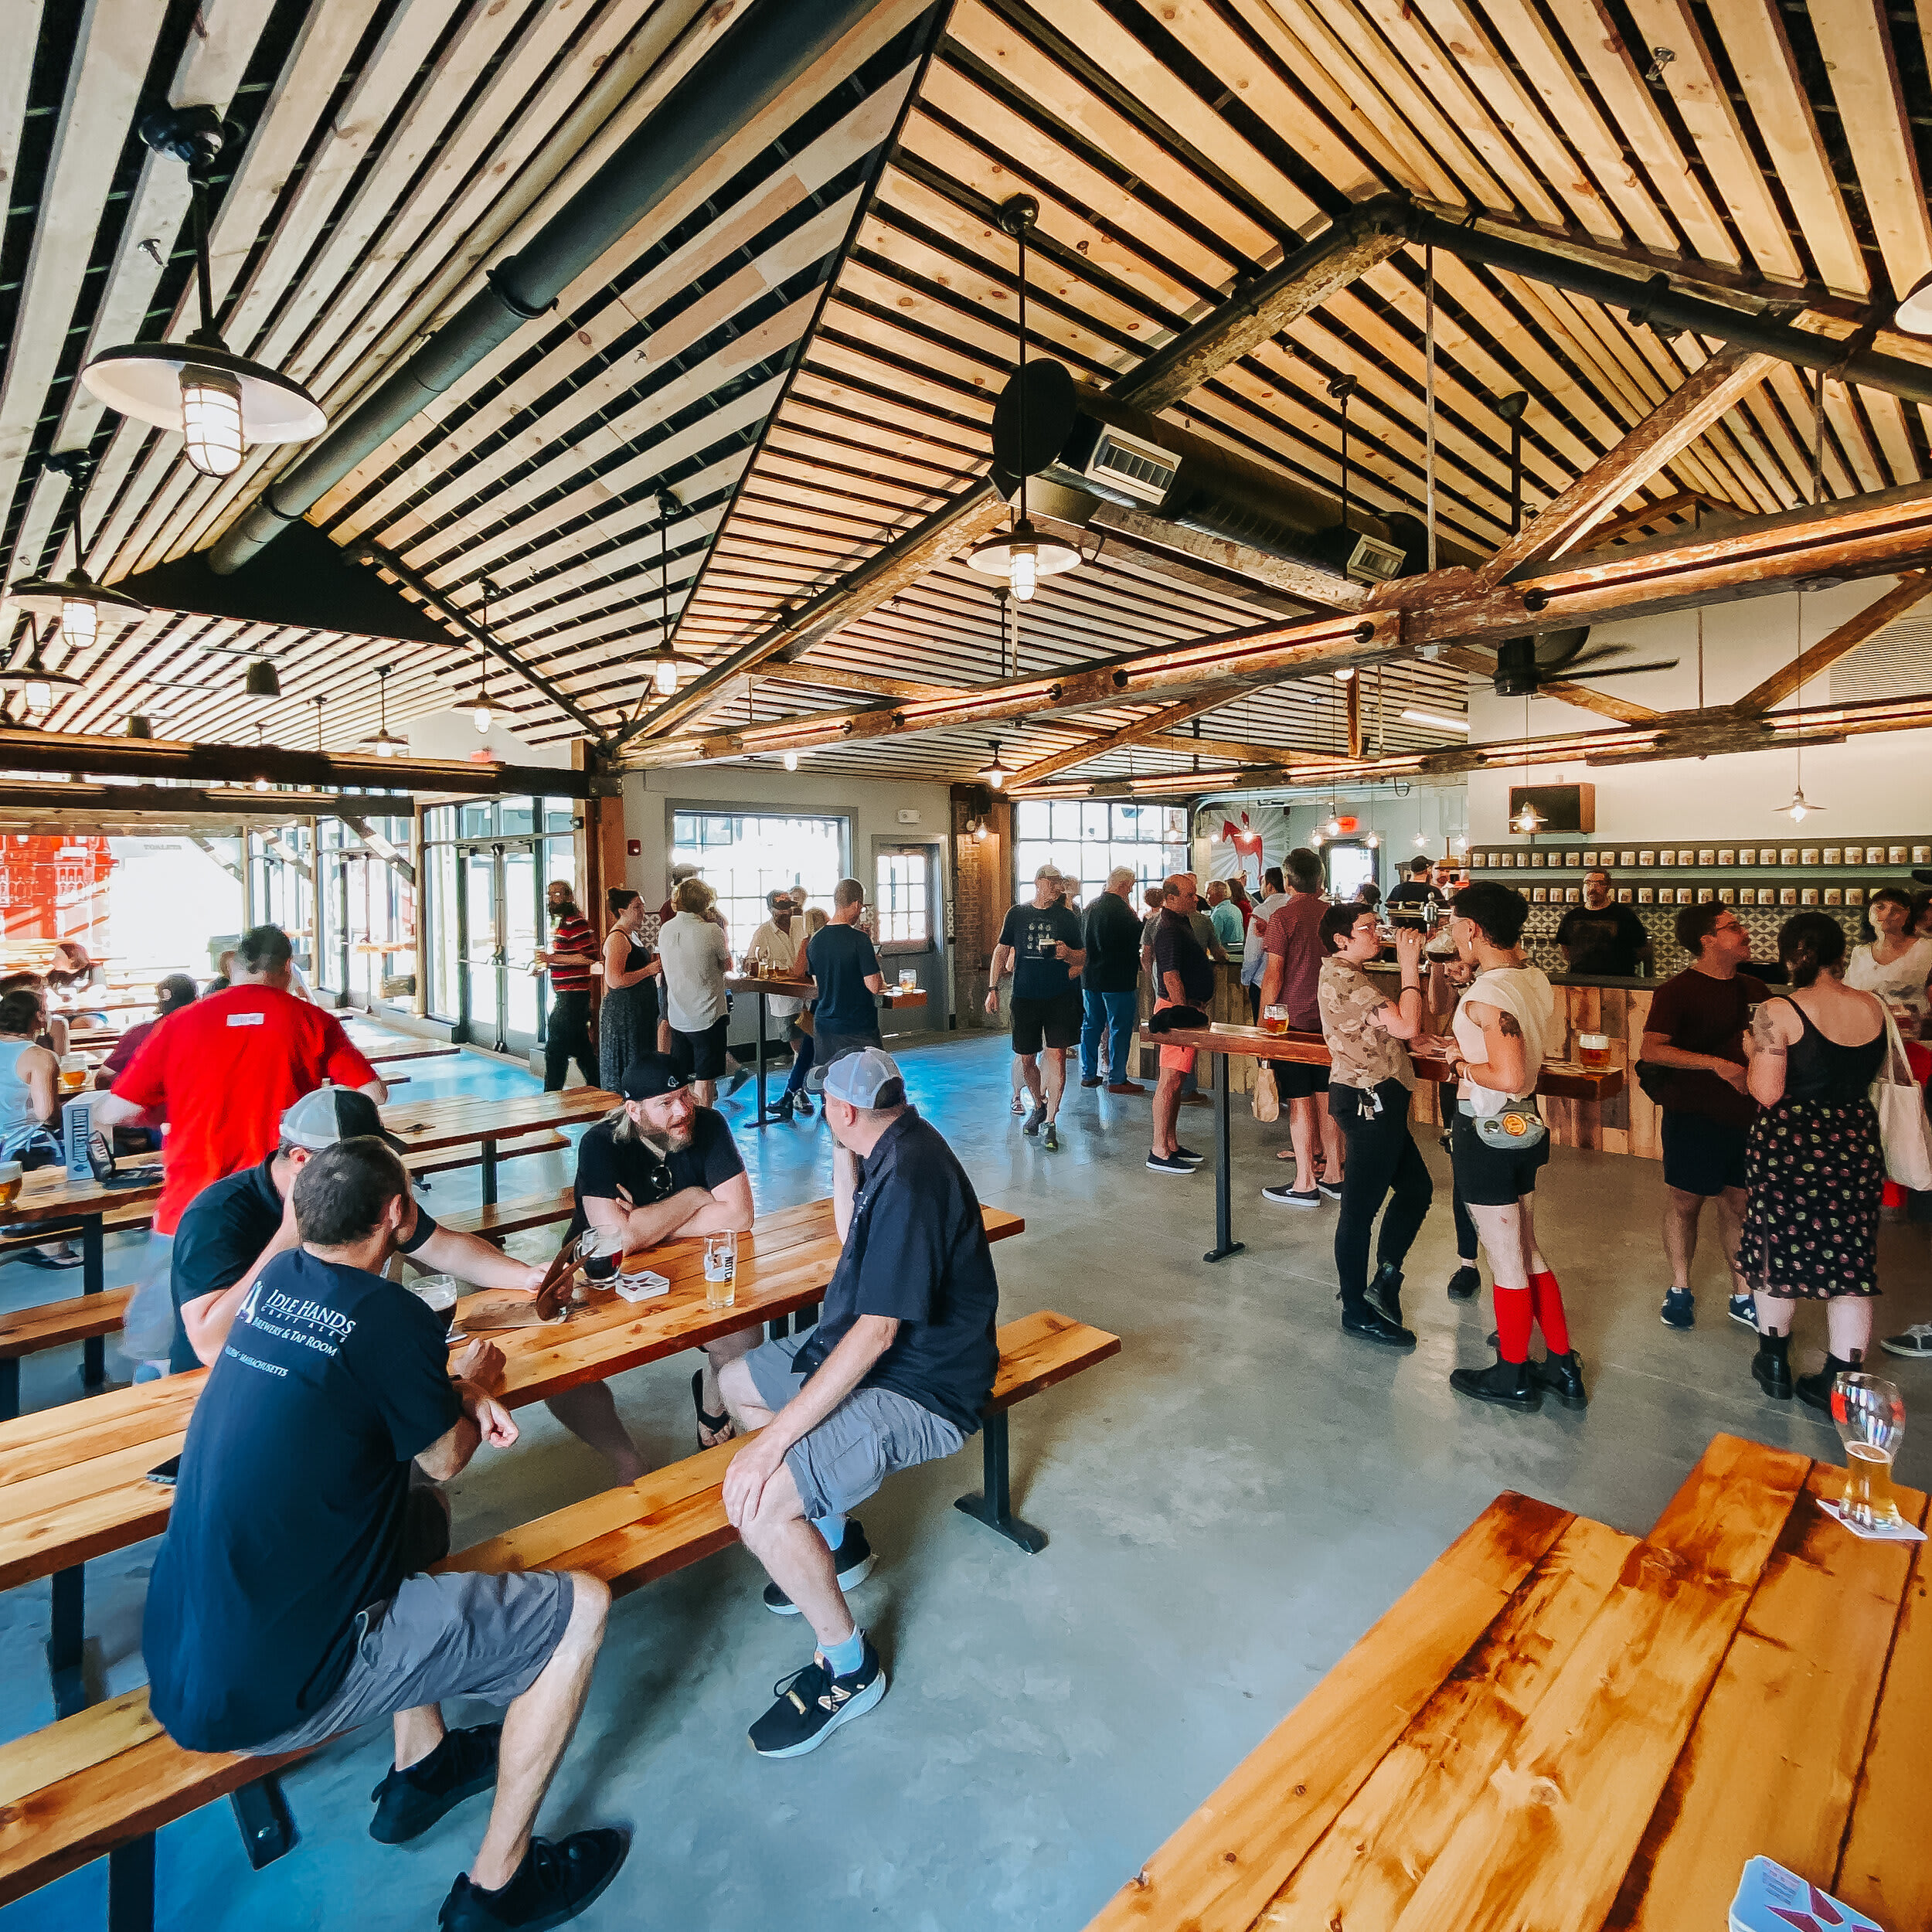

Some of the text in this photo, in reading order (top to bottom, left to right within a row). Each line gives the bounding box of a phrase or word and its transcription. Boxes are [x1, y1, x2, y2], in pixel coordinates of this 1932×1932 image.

[266, 1288, 356, 1334] IDLE HANDS
[250, 1316, 338, 1356] BREWERY & TAP ROOM
